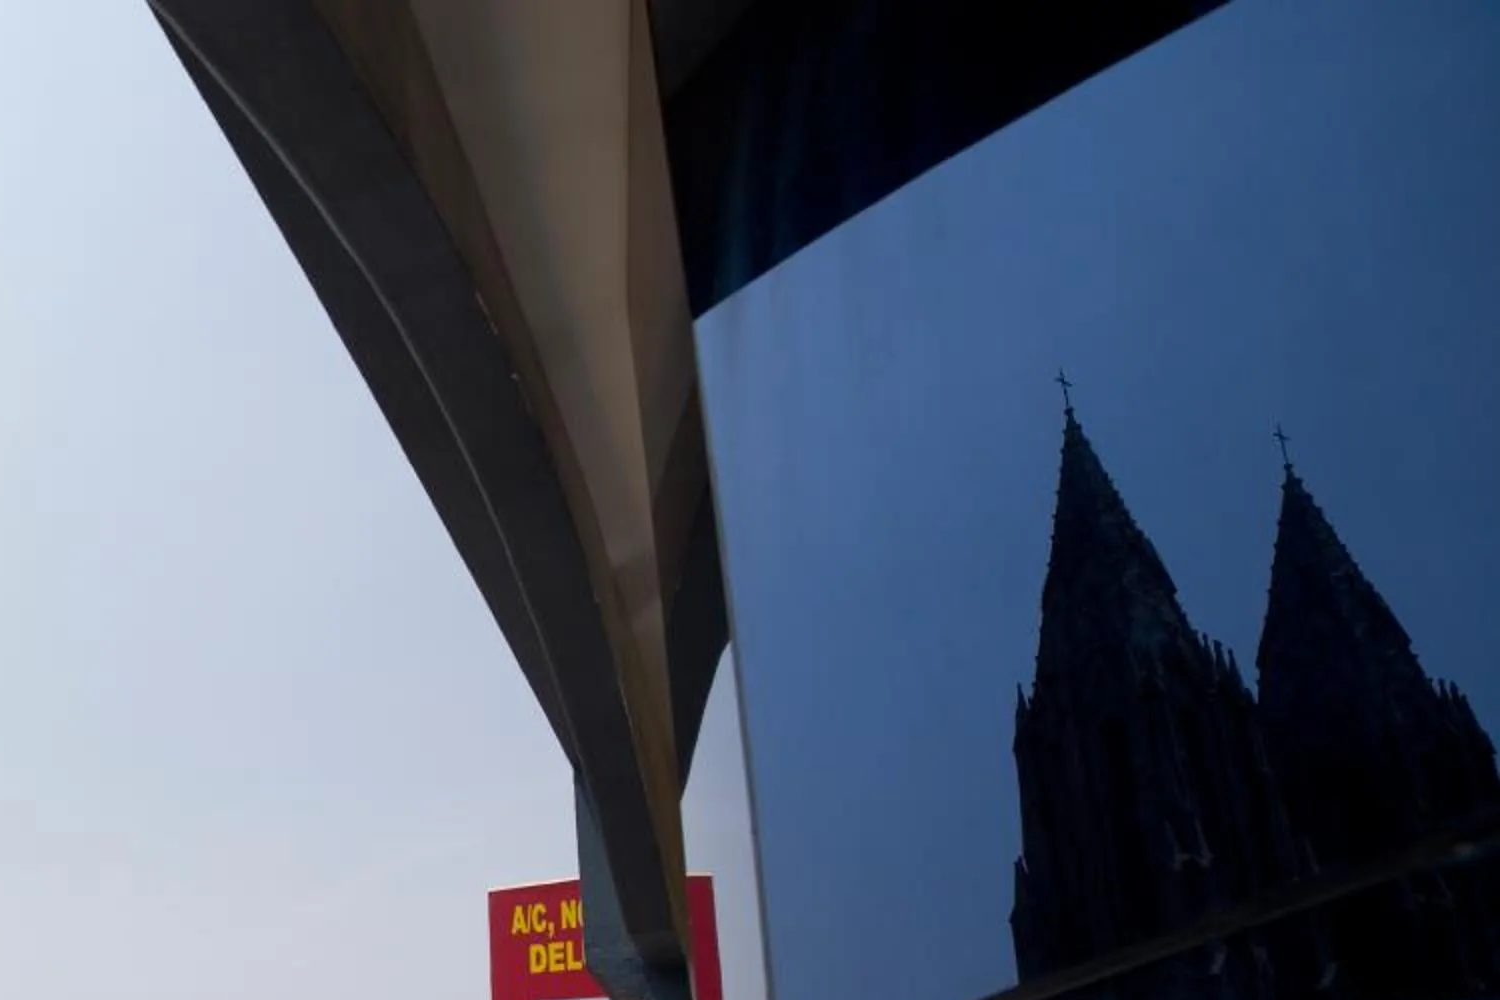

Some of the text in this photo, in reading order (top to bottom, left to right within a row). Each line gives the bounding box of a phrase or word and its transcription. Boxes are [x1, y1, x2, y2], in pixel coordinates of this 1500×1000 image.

[511, 899, 584, 937] A/C, N
[529, 941, 586, 973] DEL
